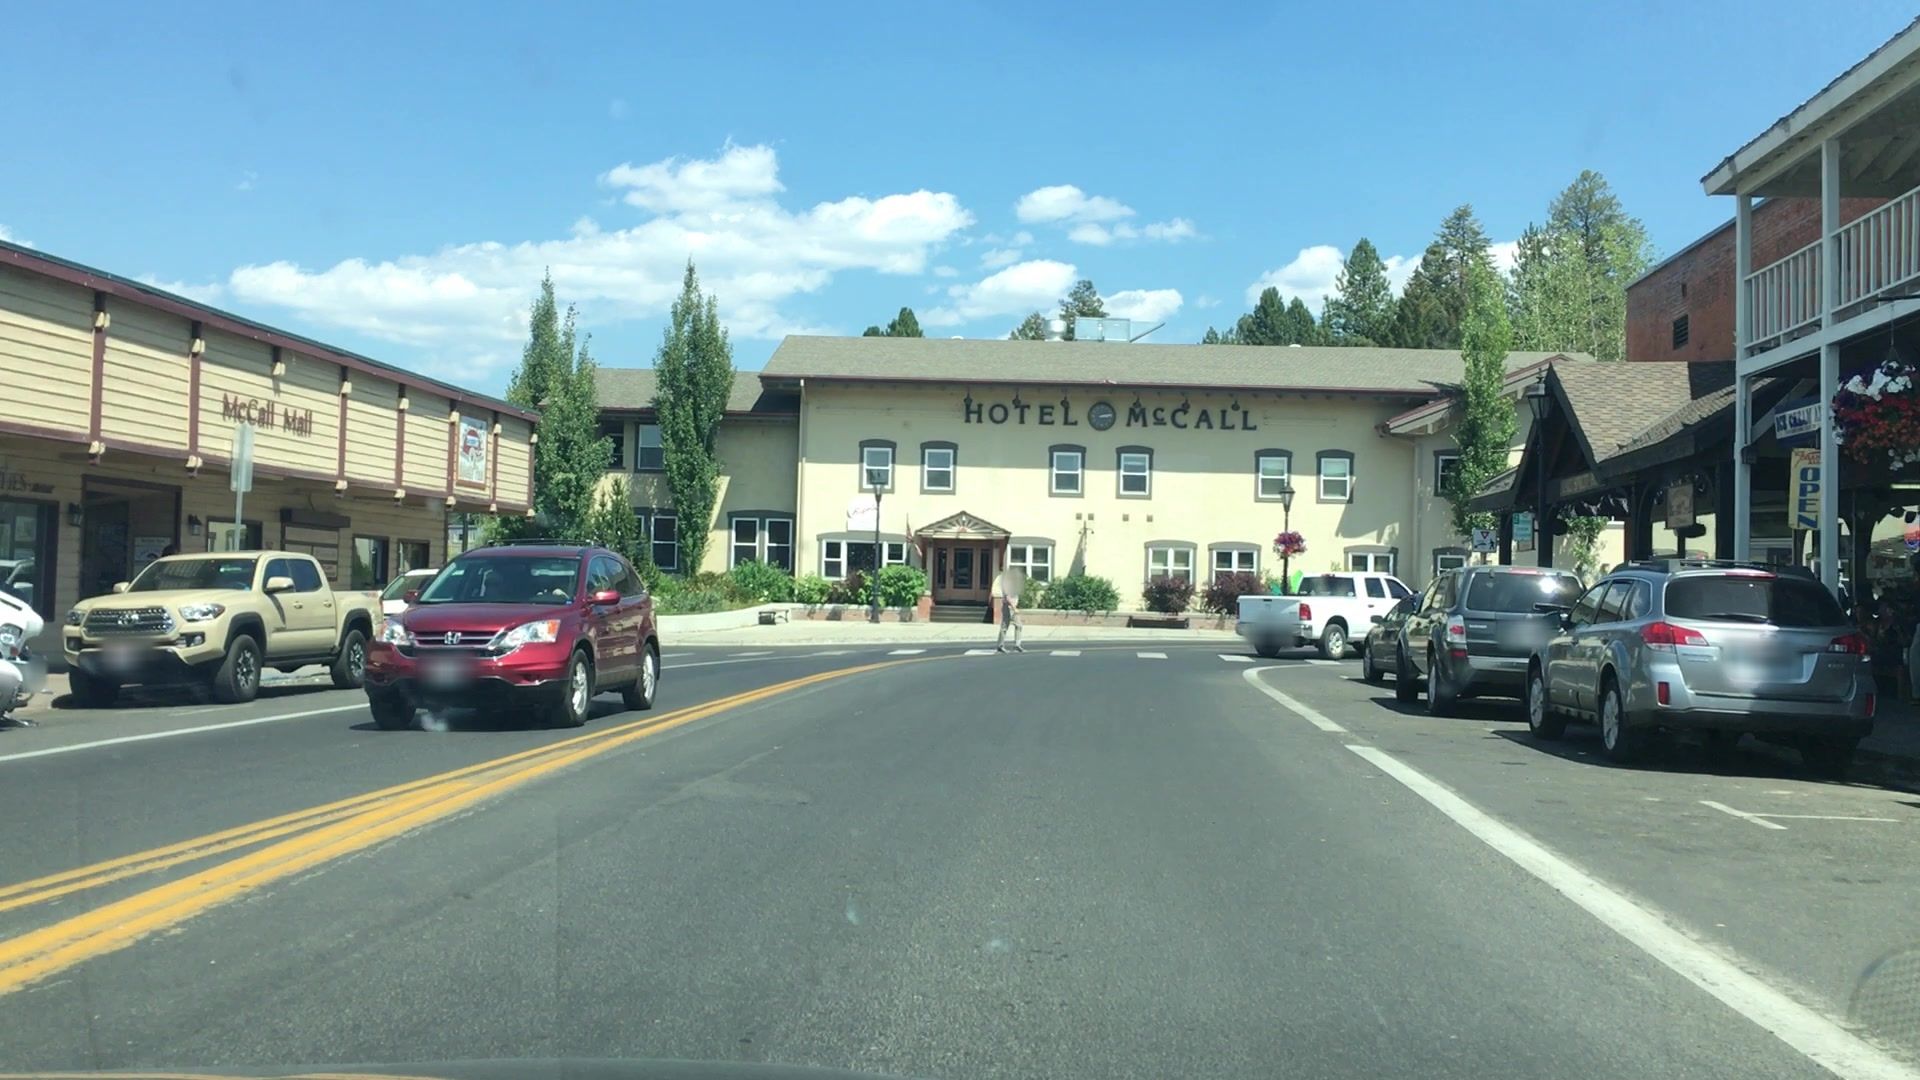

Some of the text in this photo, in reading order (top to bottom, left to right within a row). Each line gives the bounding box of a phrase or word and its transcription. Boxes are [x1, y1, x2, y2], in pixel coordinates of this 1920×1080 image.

[222, 392, 313, 438] McCall Mall
[963, 402, 1079, 426] HOTEL
[1797, 466, 1821, 529] OPEN
